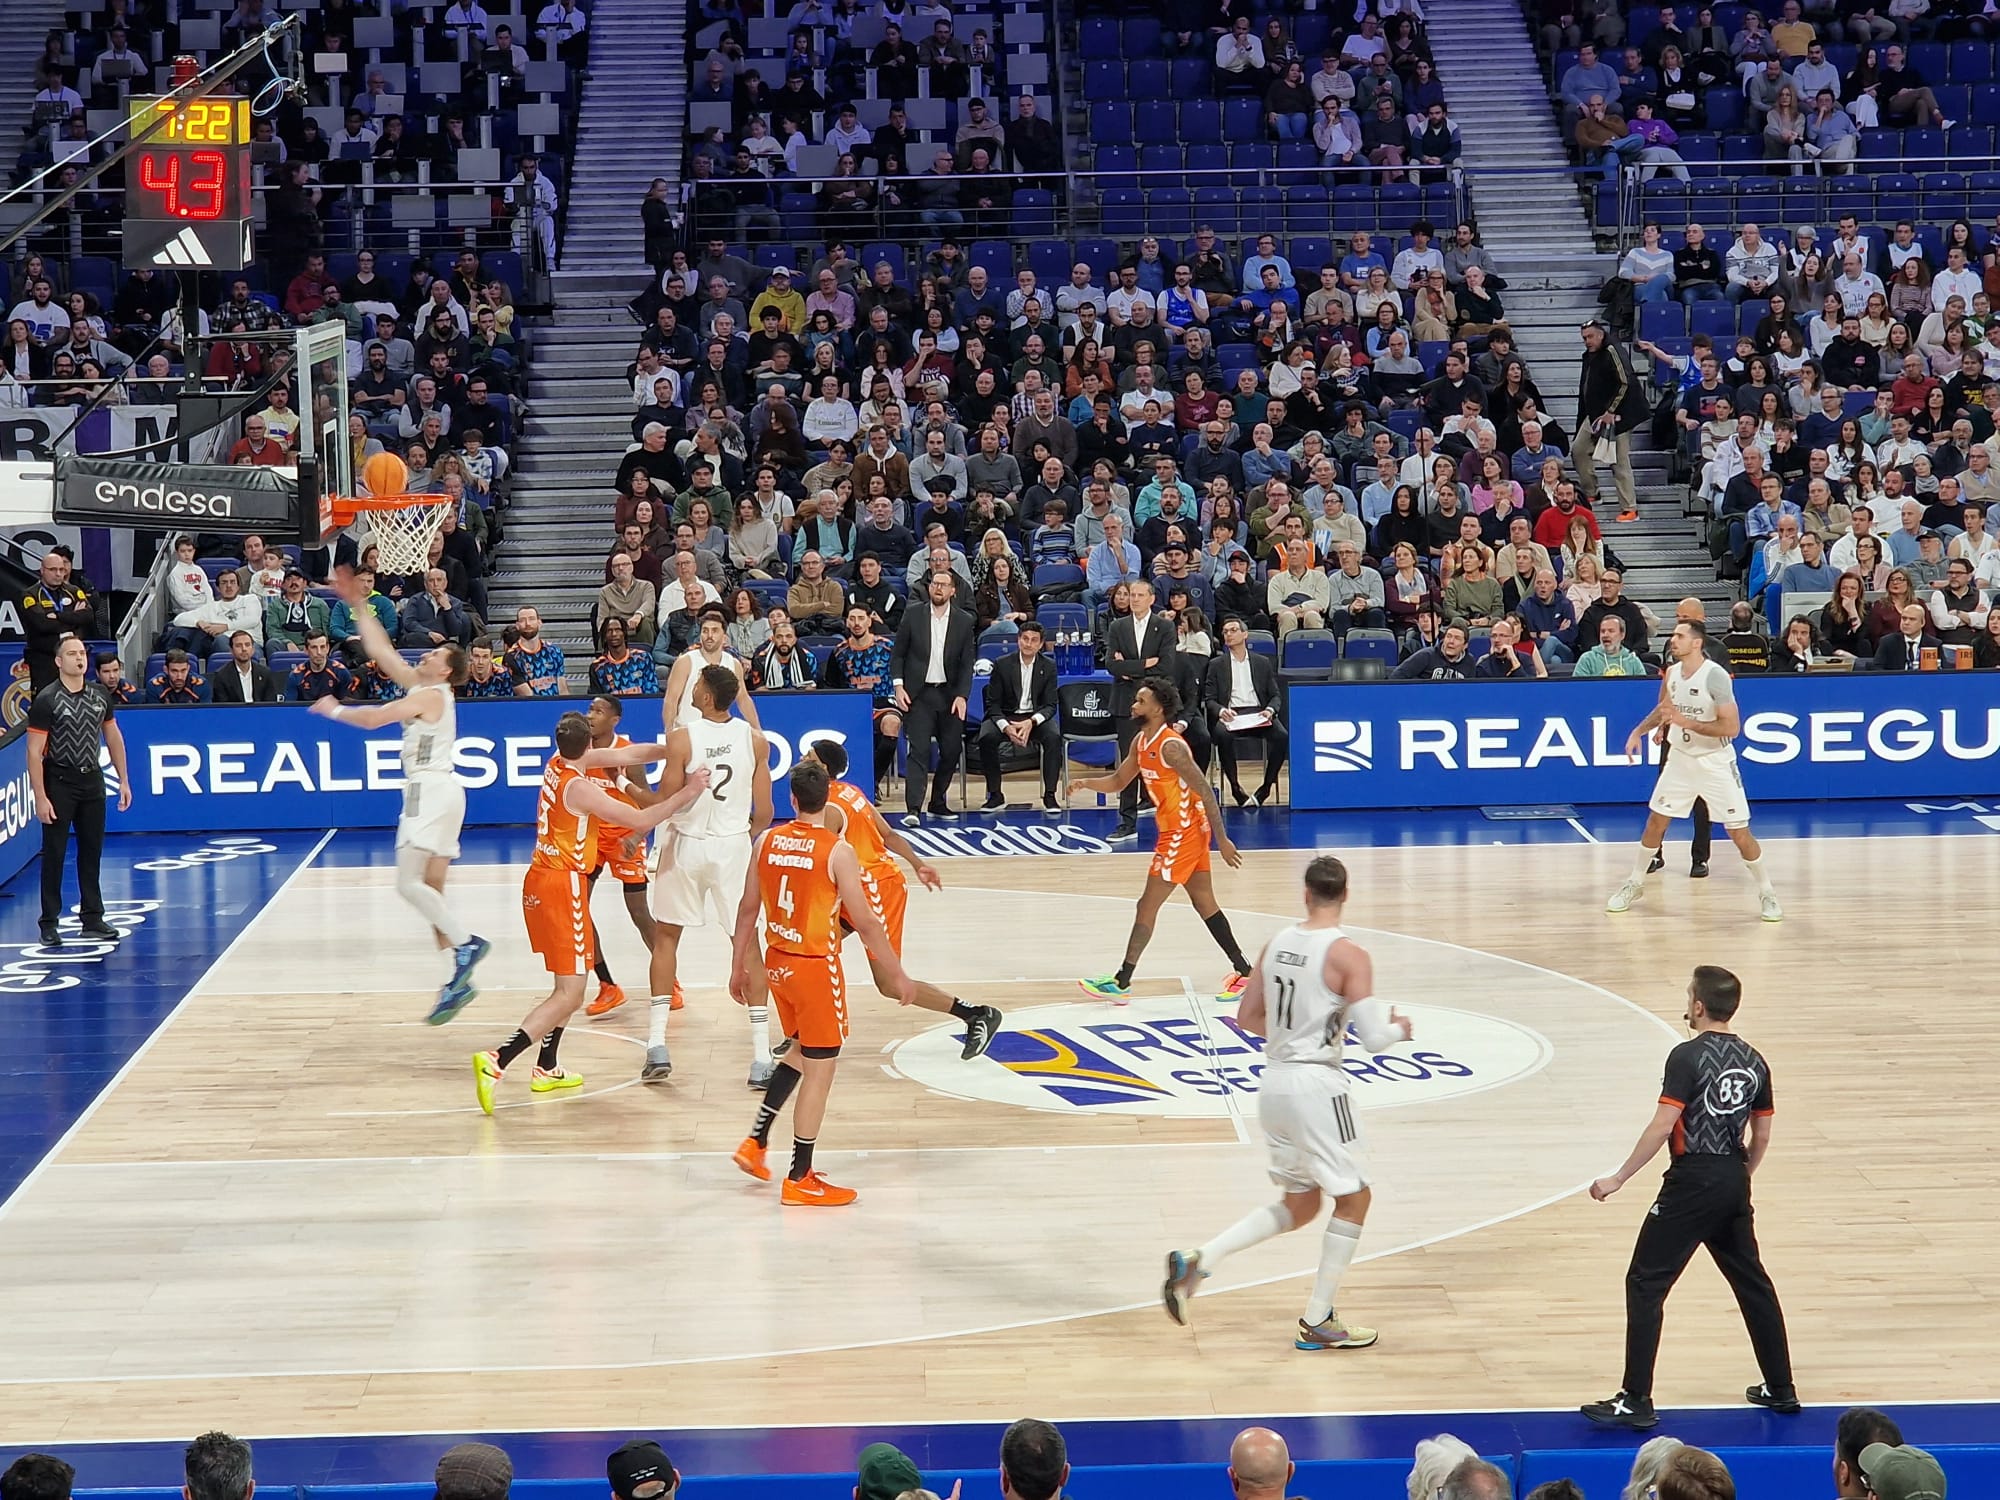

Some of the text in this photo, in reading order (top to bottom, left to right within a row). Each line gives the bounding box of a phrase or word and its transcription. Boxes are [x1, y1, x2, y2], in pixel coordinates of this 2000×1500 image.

[141, 152, 226, 219] 4.3
[94, 480, 232, 518] endesa
[712, 764, 733, 802] 2
[777, 874, 795, 920] 4
[1273, 975, 1295, 1031] 11
[1719, 1077, 1746, 1106] 83
